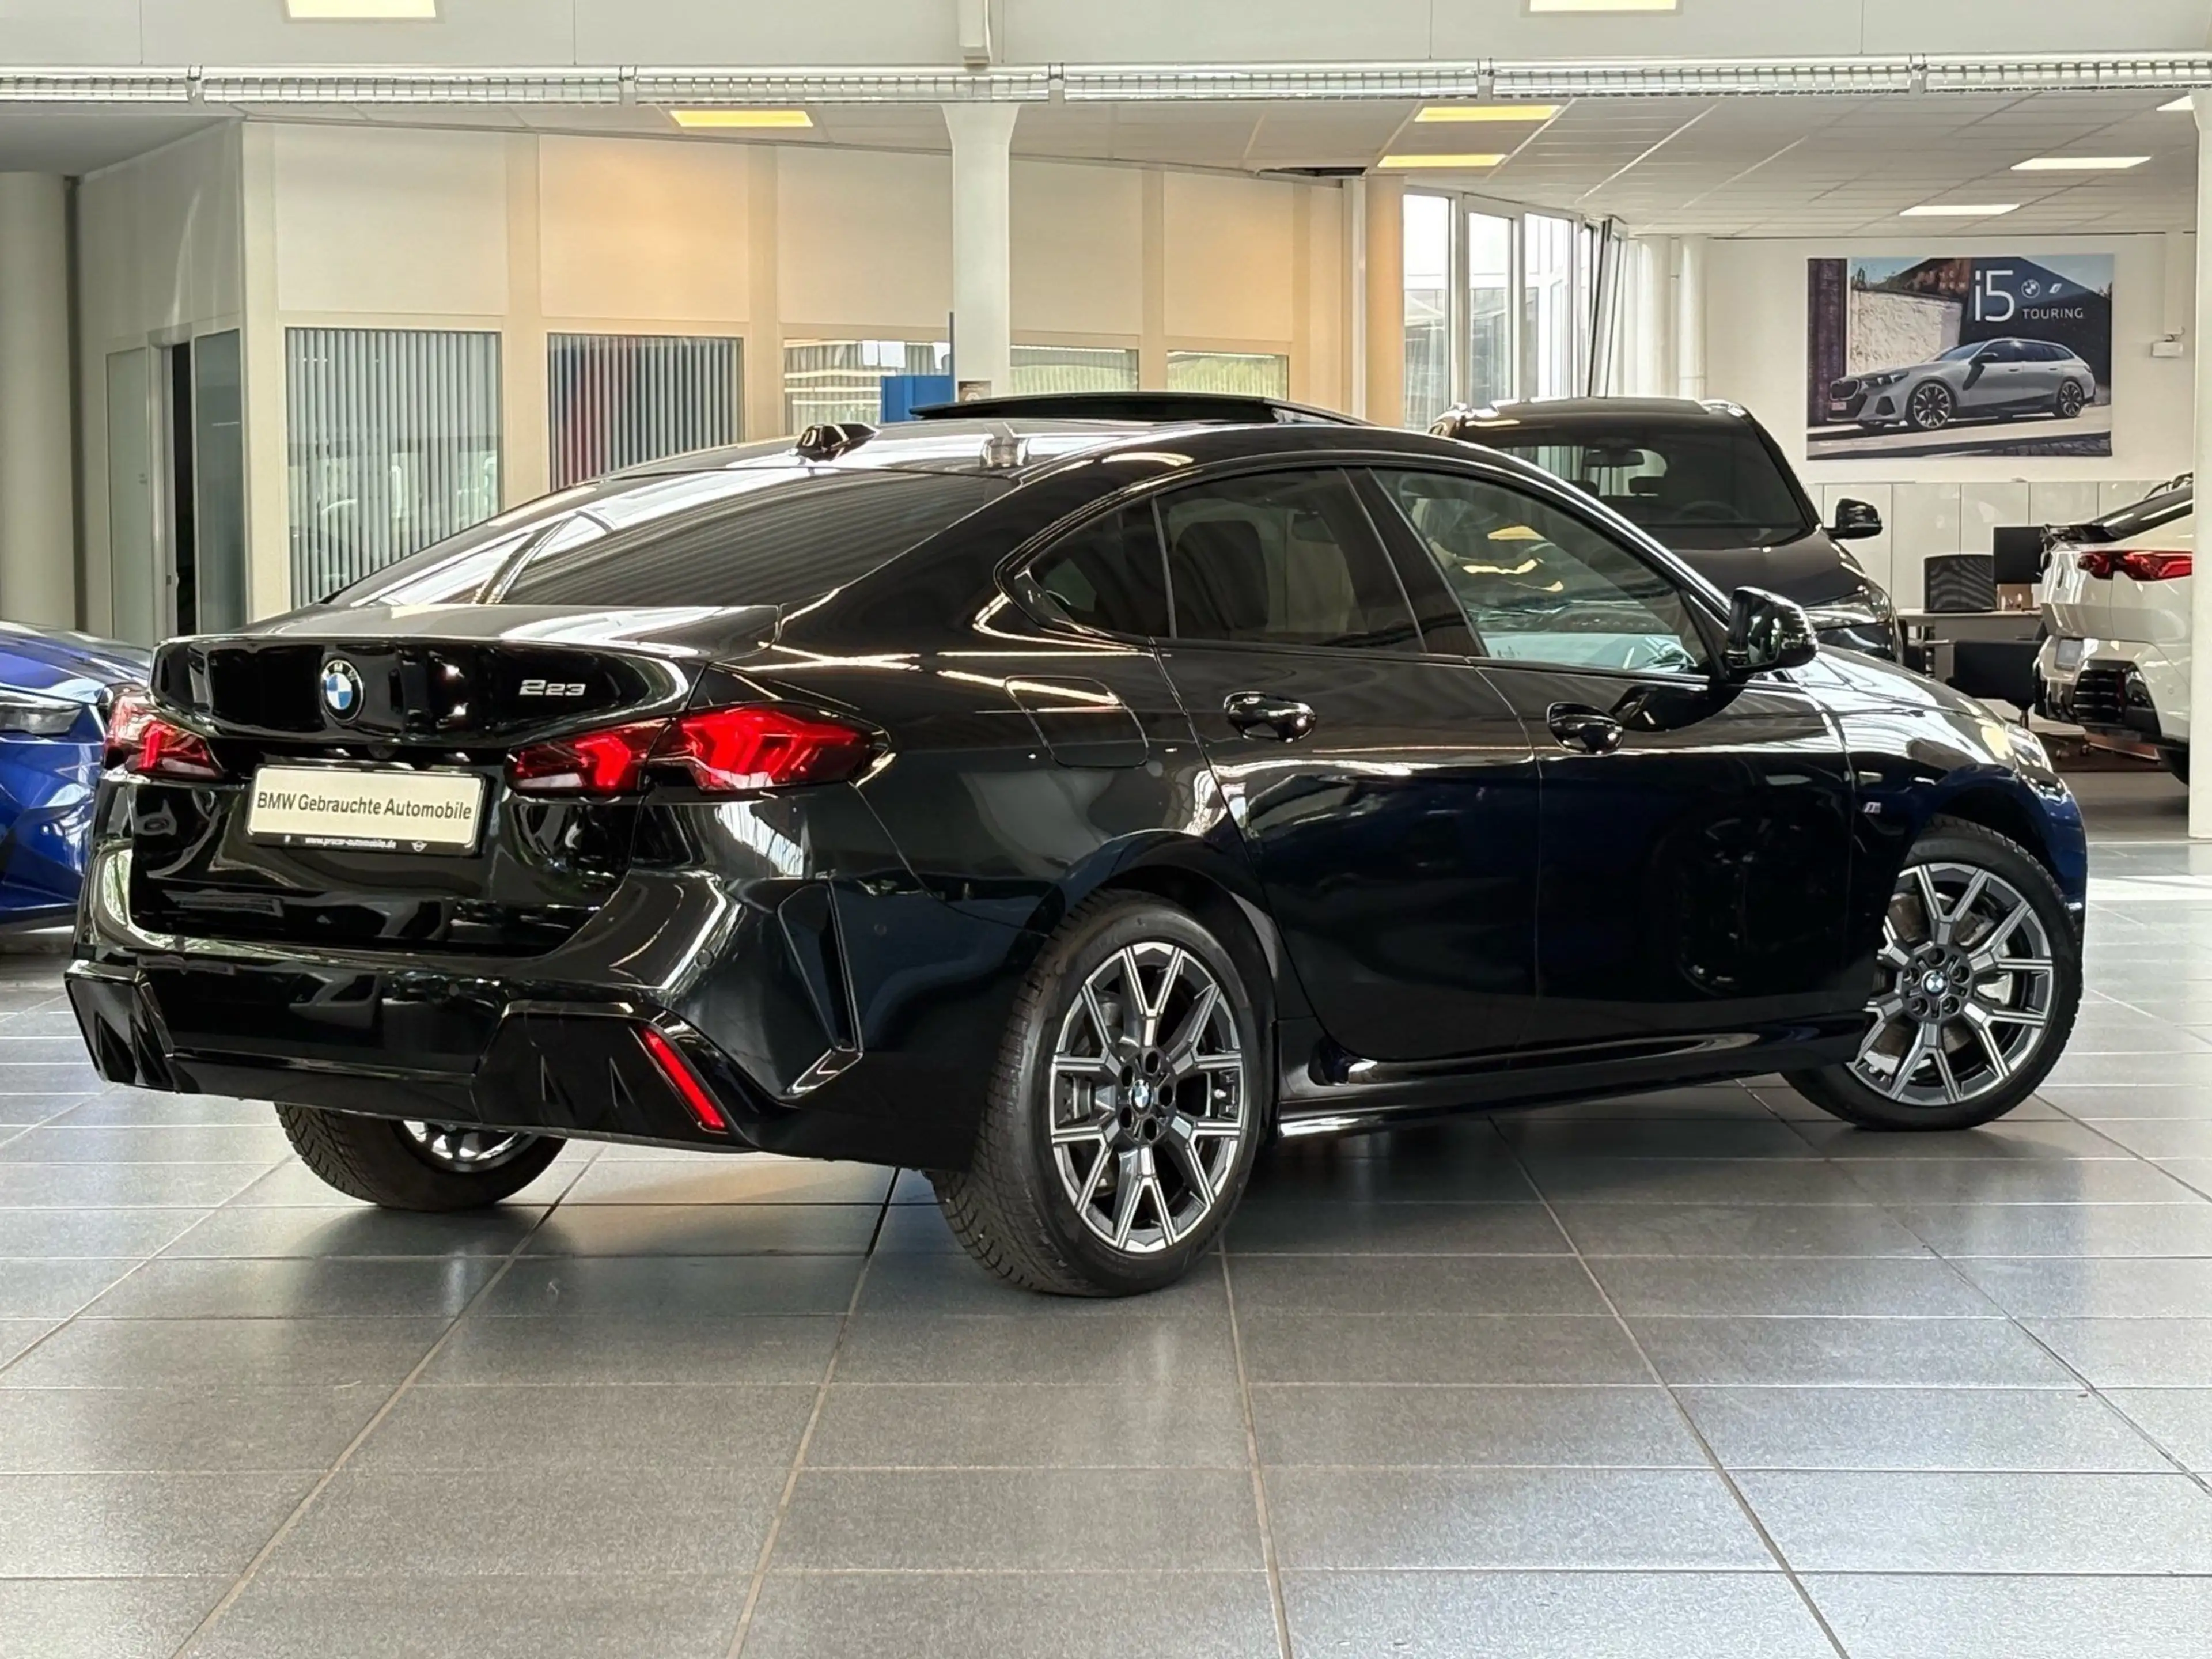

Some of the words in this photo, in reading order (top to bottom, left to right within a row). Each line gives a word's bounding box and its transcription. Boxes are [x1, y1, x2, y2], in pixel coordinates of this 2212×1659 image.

[1974, 270, 2015, 323] i5
[2022, 307, 2084, 320] TOURING
[519, 679, 586, 696] 223
[257, 791, 297, 810] BMW
[298, 793, 381, 815] Gebrauchte
[384, 798, 472, 820] Automobile
